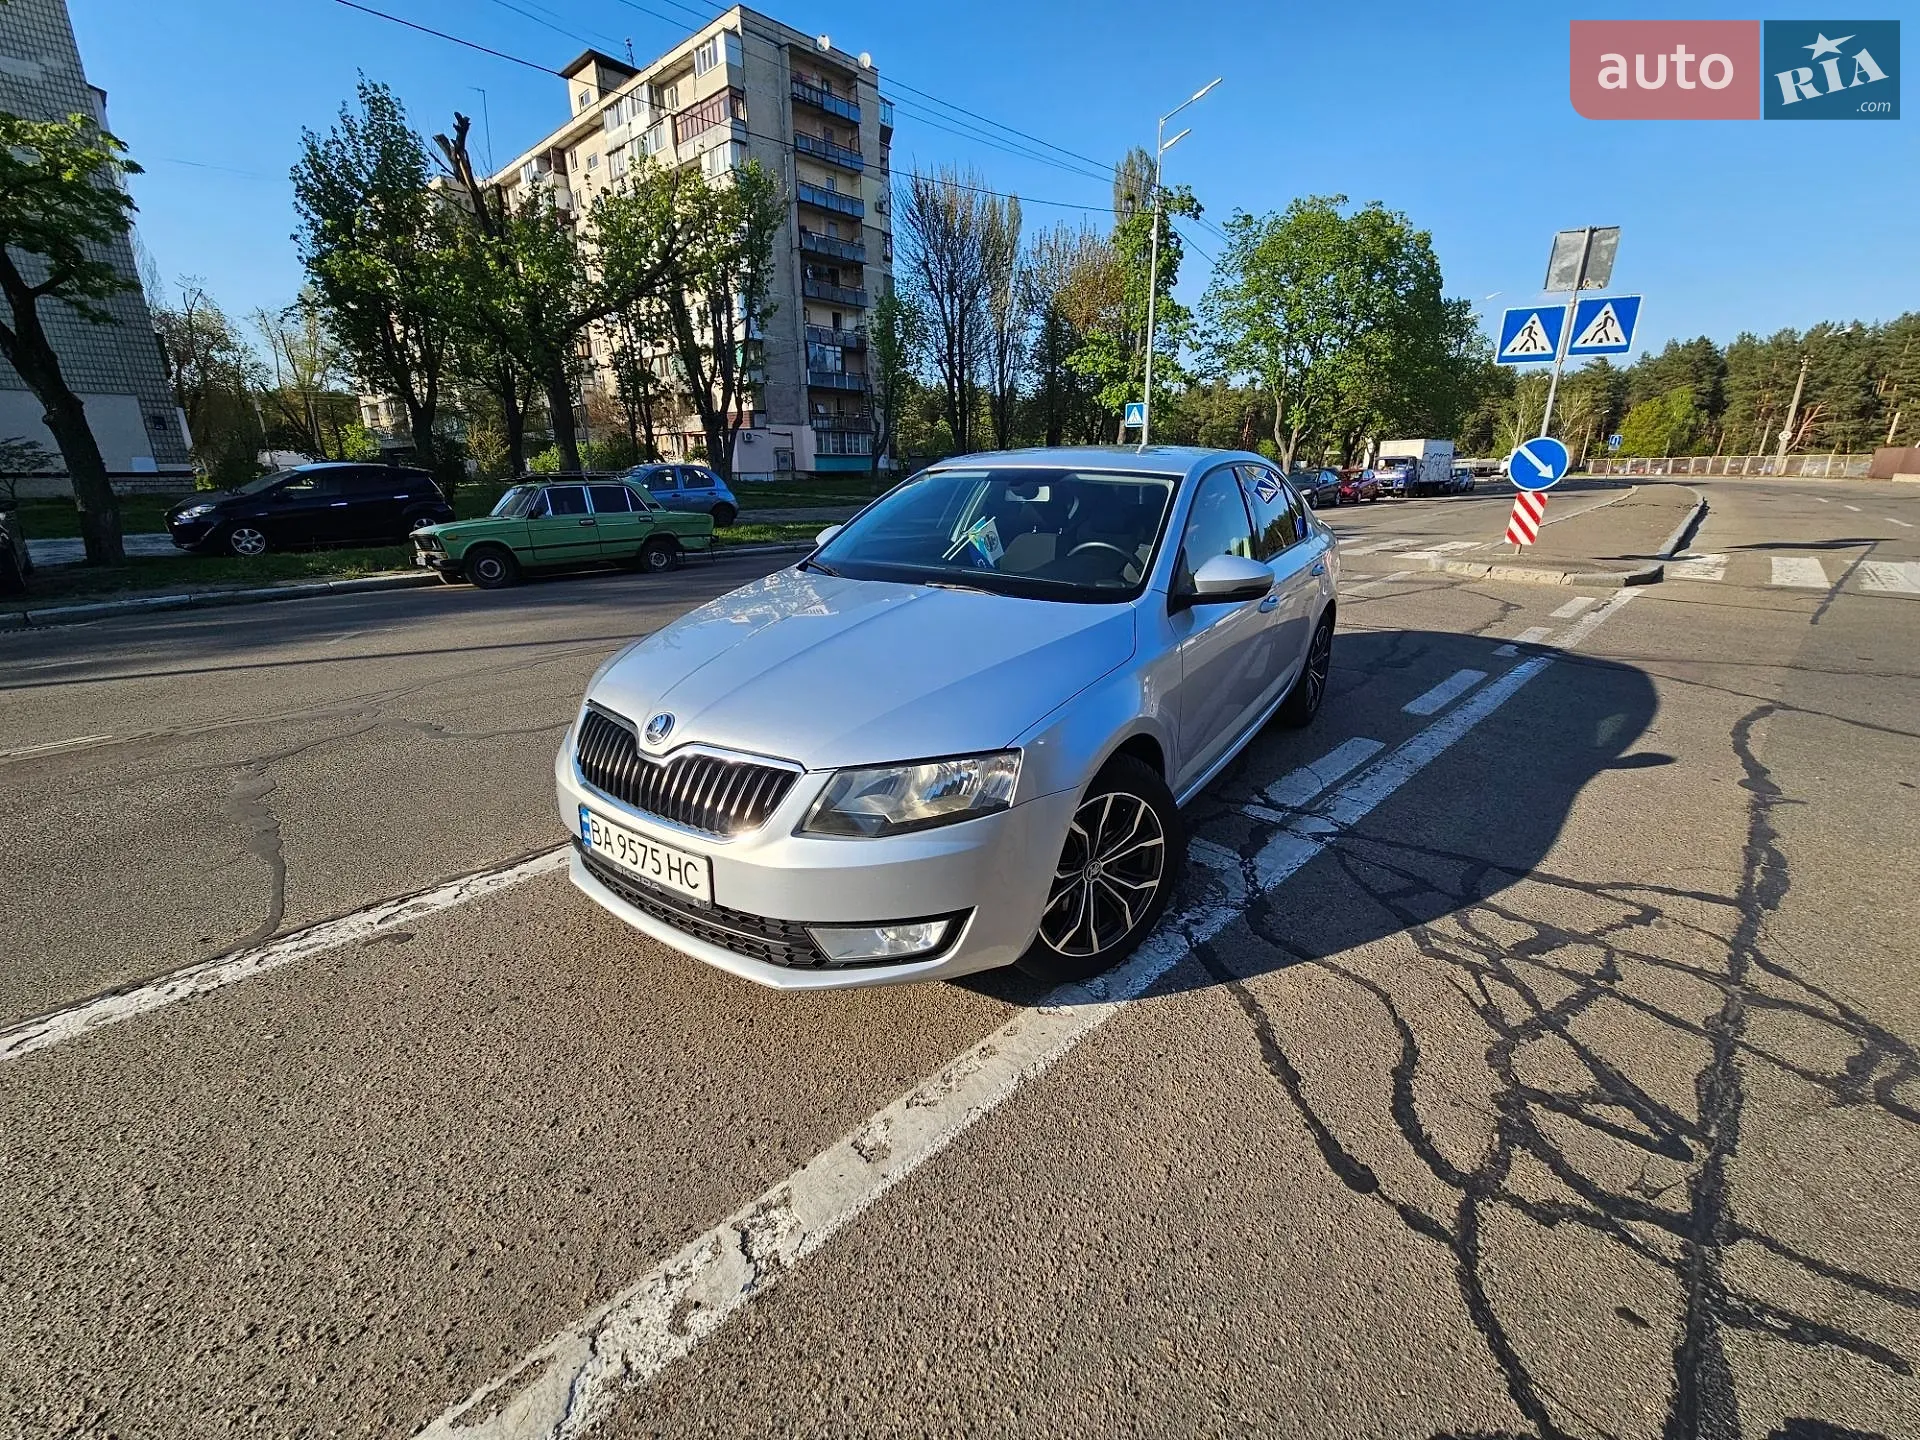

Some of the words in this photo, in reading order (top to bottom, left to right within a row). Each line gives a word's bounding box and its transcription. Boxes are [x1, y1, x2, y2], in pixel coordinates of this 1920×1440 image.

[591, 819, 614, 854] BA
[617, 834, 662, 875] 9575
[667, 853, 699, 890] HC
